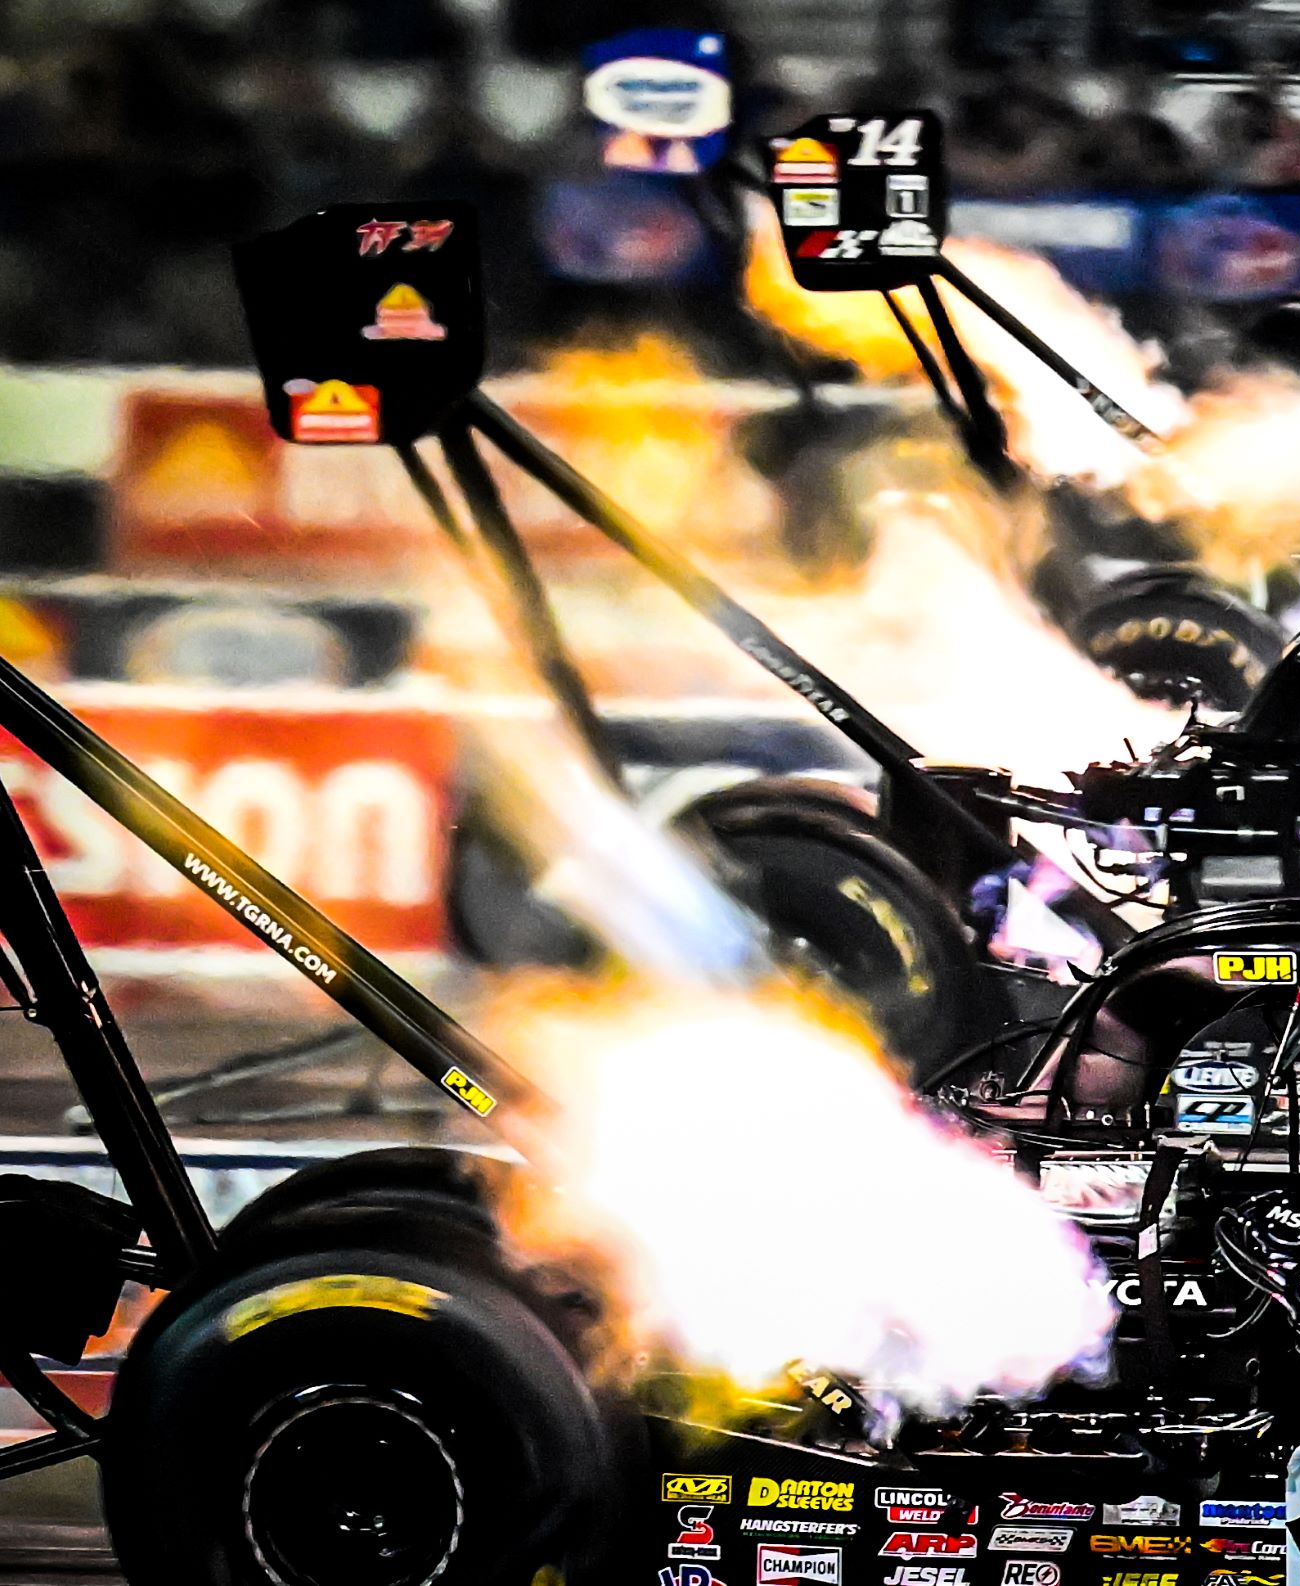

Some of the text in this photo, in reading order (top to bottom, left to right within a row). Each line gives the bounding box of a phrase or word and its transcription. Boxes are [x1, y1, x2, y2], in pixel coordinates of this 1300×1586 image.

[848, 119, 923, 166] 14
[184, 853, 337, 984] WWW.TGRNA.COM
[1217, 956, 1292, 982] PJH
[445, 1070, 495, 1116] PJH
[747, 1476, 855, 1507] DARTON
[776, 1494, 854, 1512] SLEEVES
[739, 1518, 861, 1536] HANGSTERFER'S
[884, 1533, 977, 1554] ARP
[763, 1558, 836, 1575] CHAMPION
[883, 1566, 971, 1586] JESEL
